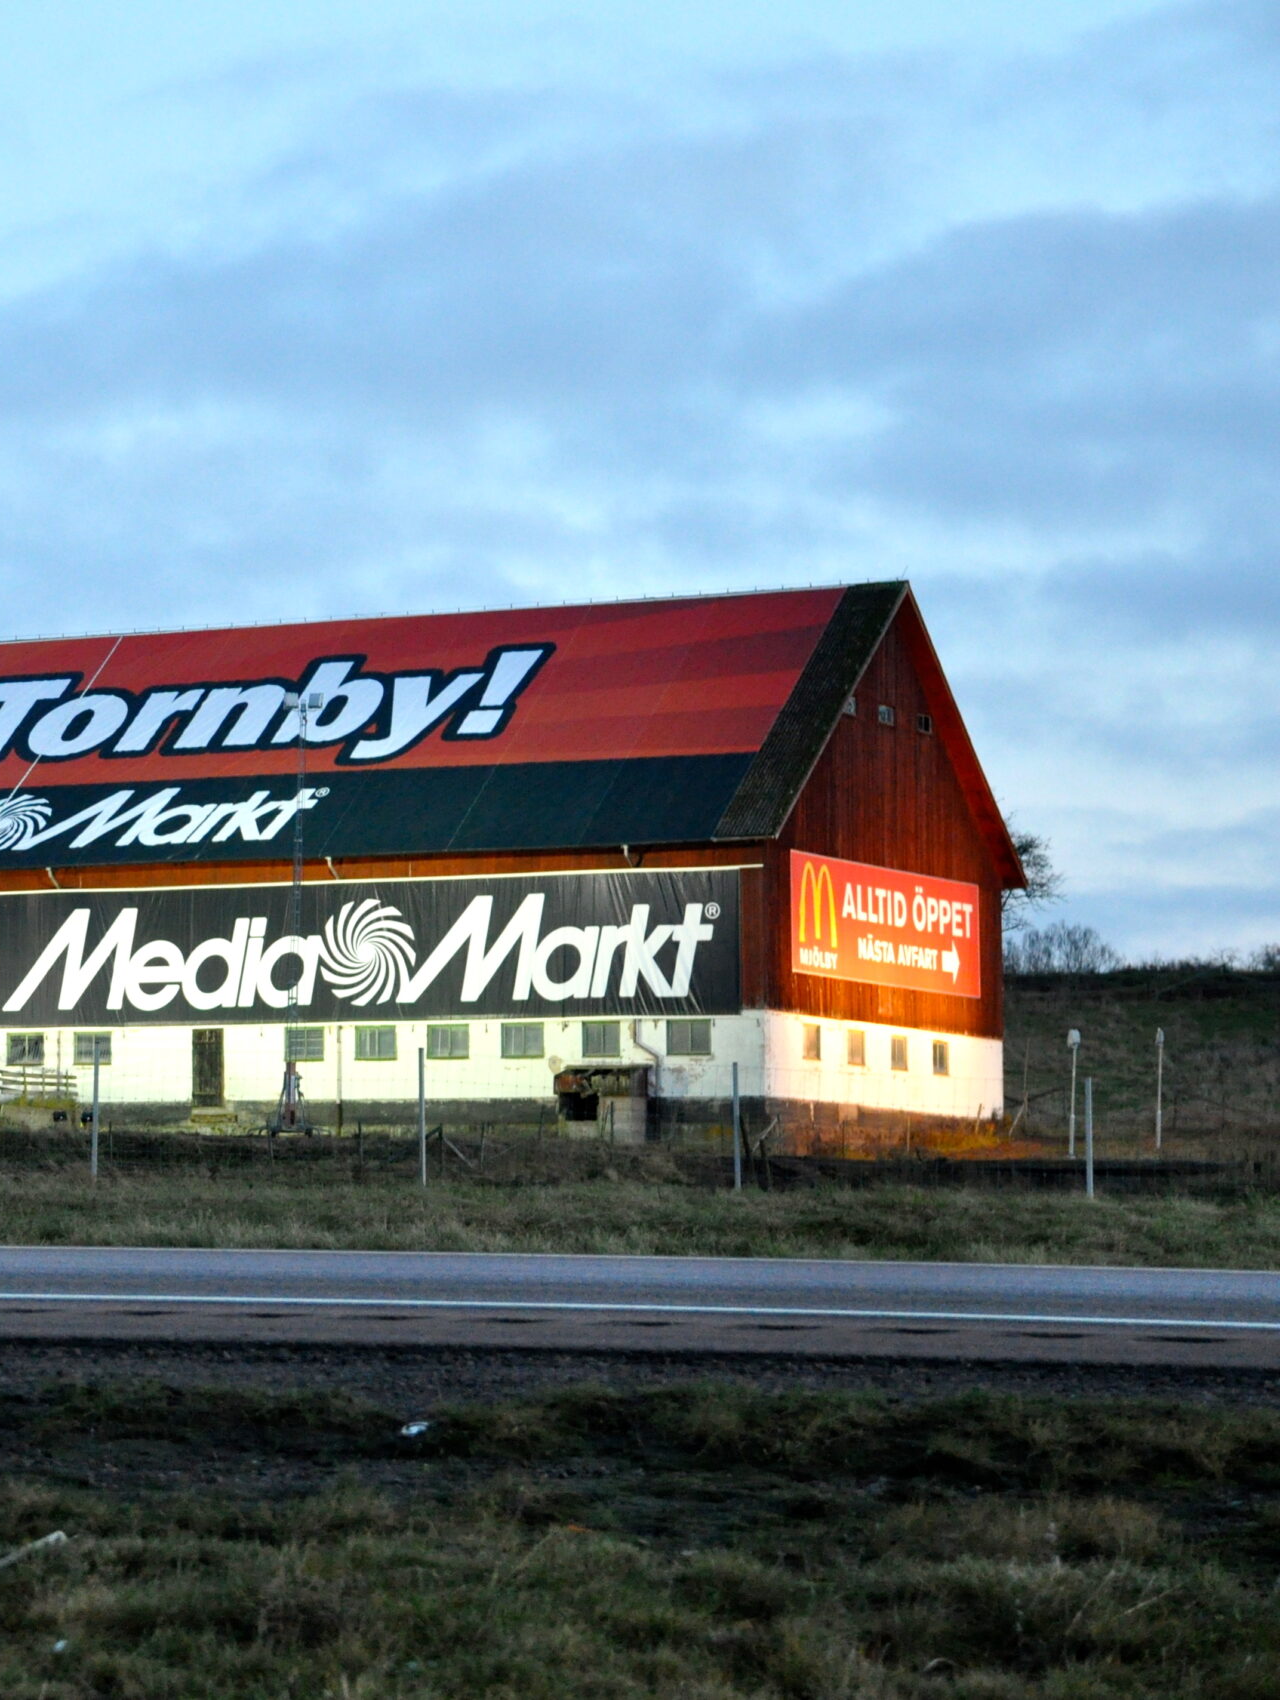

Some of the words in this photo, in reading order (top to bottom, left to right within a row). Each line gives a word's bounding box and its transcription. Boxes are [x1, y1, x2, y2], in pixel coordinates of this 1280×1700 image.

[841, 882, 907, 928] ALLTID
[912, 886, 973, 939] ÖPPET
[2, 906, 322, 1013] Media
[799, 946, 838, 970] MJÖLBY
[857, 933, 896, 965] NÄSTA
[897, 944, 938, 971] AVFART
